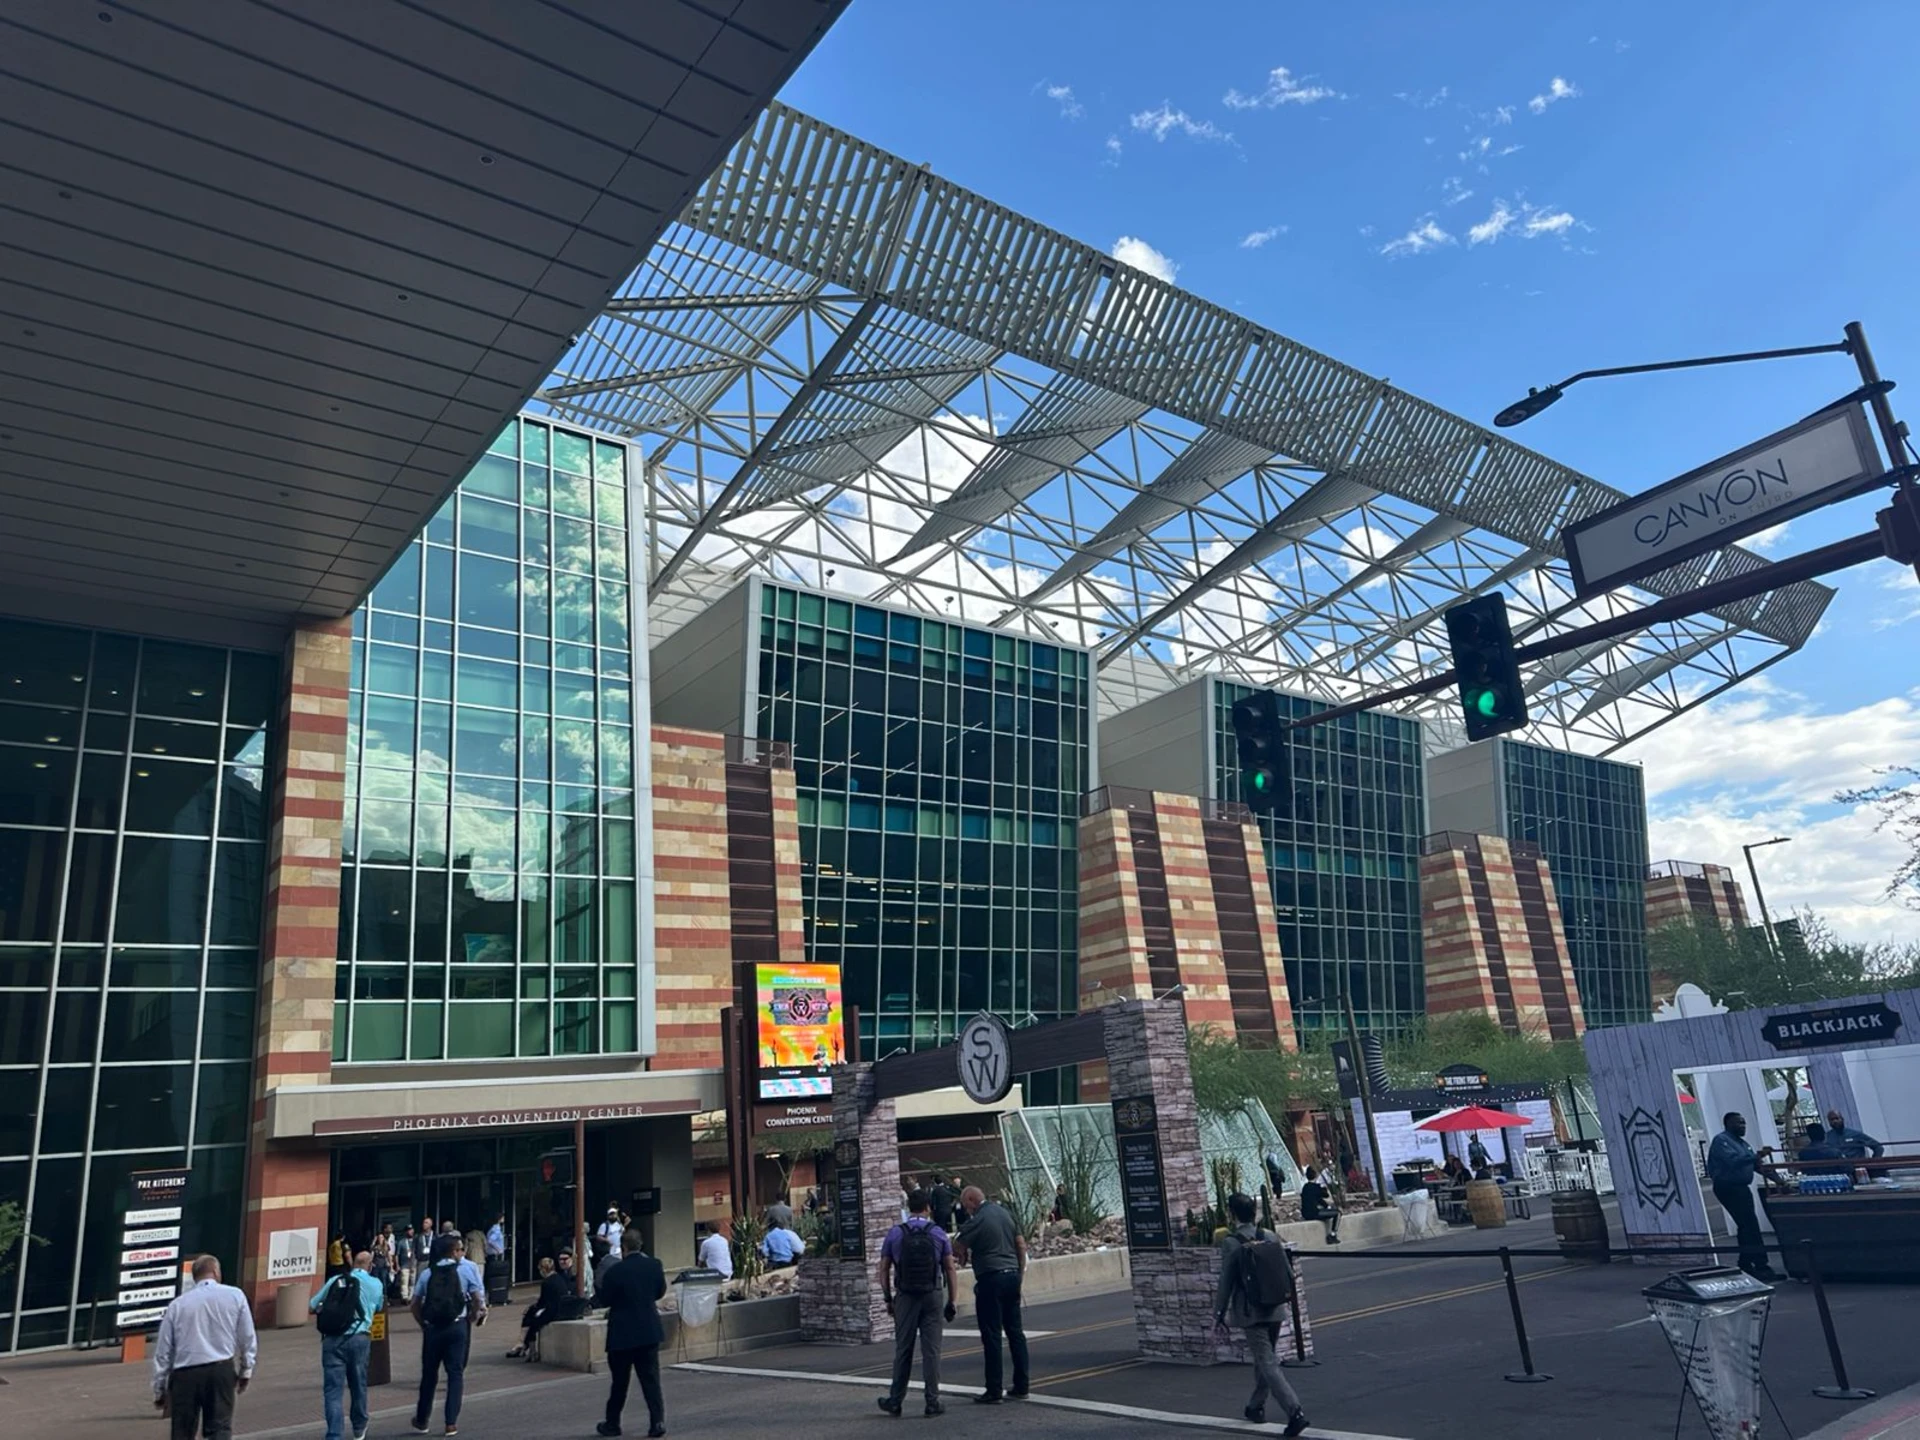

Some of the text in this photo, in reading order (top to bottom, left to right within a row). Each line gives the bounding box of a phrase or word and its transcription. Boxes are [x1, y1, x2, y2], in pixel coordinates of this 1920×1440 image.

[1635, 458, 1789, 547] CANYON
[1718, 490, 1793, 525] ON THIRD
[1778, 1013, 1883, 1038] BLACKJACK
[787, 1106, 818, 1115] PHOENIX
[393, 1106, 643, 1130] PHOENIX CONVENTION CENTER
[766, 1115, 833, 1127] CONVENTION CENTE
[152, 1177, 186, 1188] KITCHENS
[273, 1256, 312, 1268] NORTH
[273, 1267, 311, 1275] BUILDING
